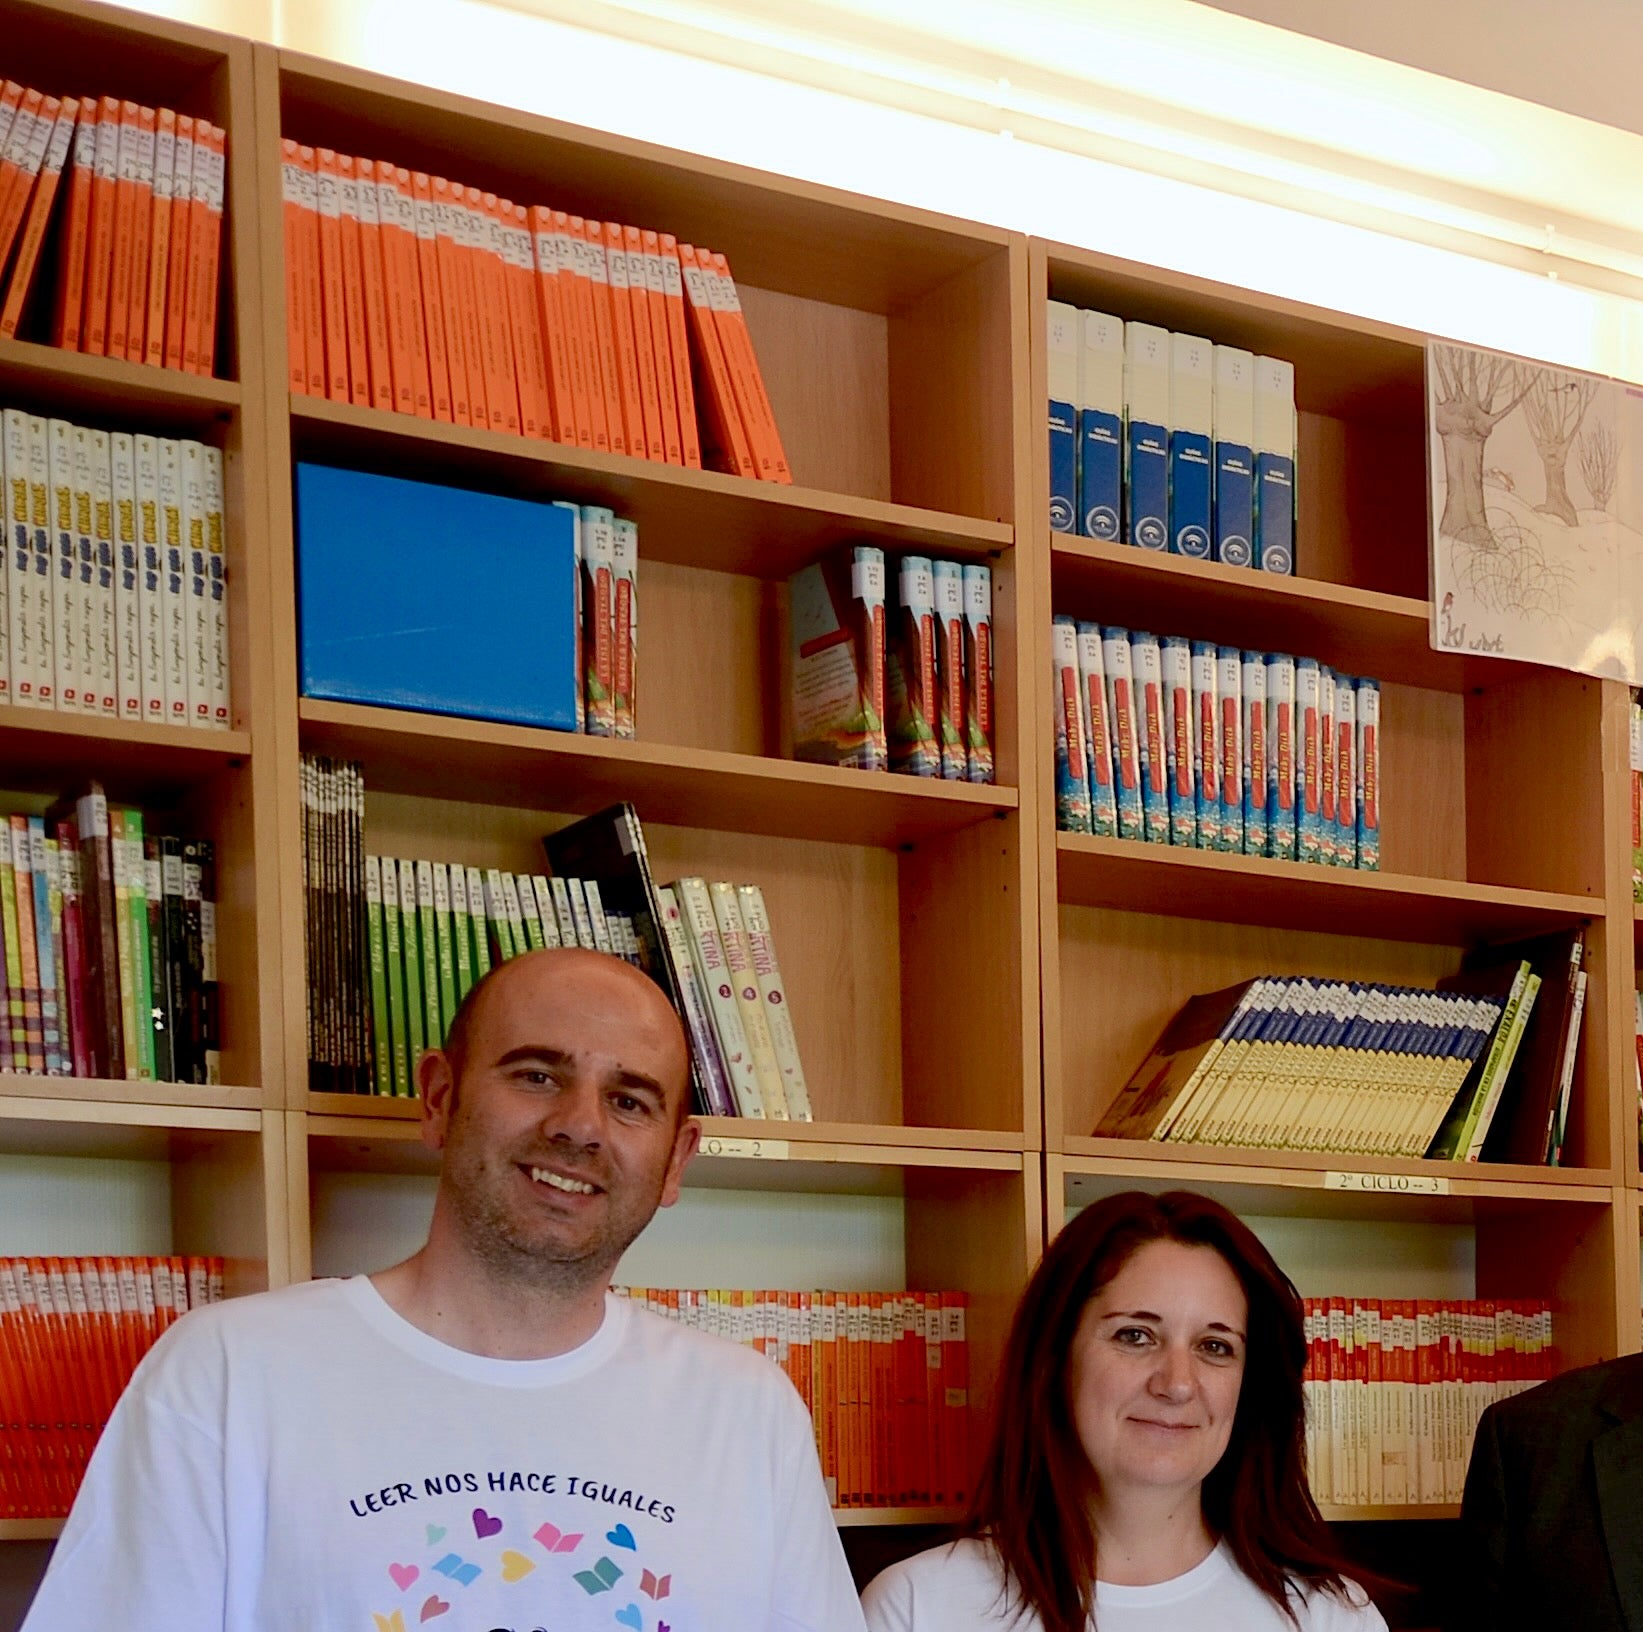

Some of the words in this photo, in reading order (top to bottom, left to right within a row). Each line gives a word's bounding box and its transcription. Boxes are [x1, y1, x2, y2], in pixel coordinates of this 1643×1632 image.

[1066, 696, 1075, 719] Dick
[1092, 704, 1101, 726] Dick
[1118, 708, 1128, 730] Dick
[1148, 711, 1157, 734] Dick
[1176, 716, 1184, 738] Dick
[1203, 721, 1211, 742] Dick
[1068, 723, 1077, 749] Moby
[1094, 730, 1103, 754] Moby
[1121, 734, 1130, 759] Moby
[1224, 726, 1233, 748] Dick
[1252, 730, 1260, 751] Dick
[1279, 731, 1287, 752] Dick
[1306, 736, 1314, 756] Dick
[1150, 738, 1159, 763] Moby
[1178, 742, 1186, 767] Moby
[1203, 746, 1212, 771] Moby
[1225, 751, 1234, 777] Moby
[1253, 754, 1261, 780] Moby
[1280, 756, 1288, 781] Moby
[1307, 760, 1315, 785] Moby
[753, 1142, 762, 1157] 2
[1360, 1174, 1409, 1190] CICLO
[1431, 1178, 1439, 1191] 3
[350, 1482, 418, 1518] LEER
[424, 1473, 479, 1497] NOS
[487, 1471, 557, 1495] HACE
[566, 1476, 676, 1524] IGUALES
